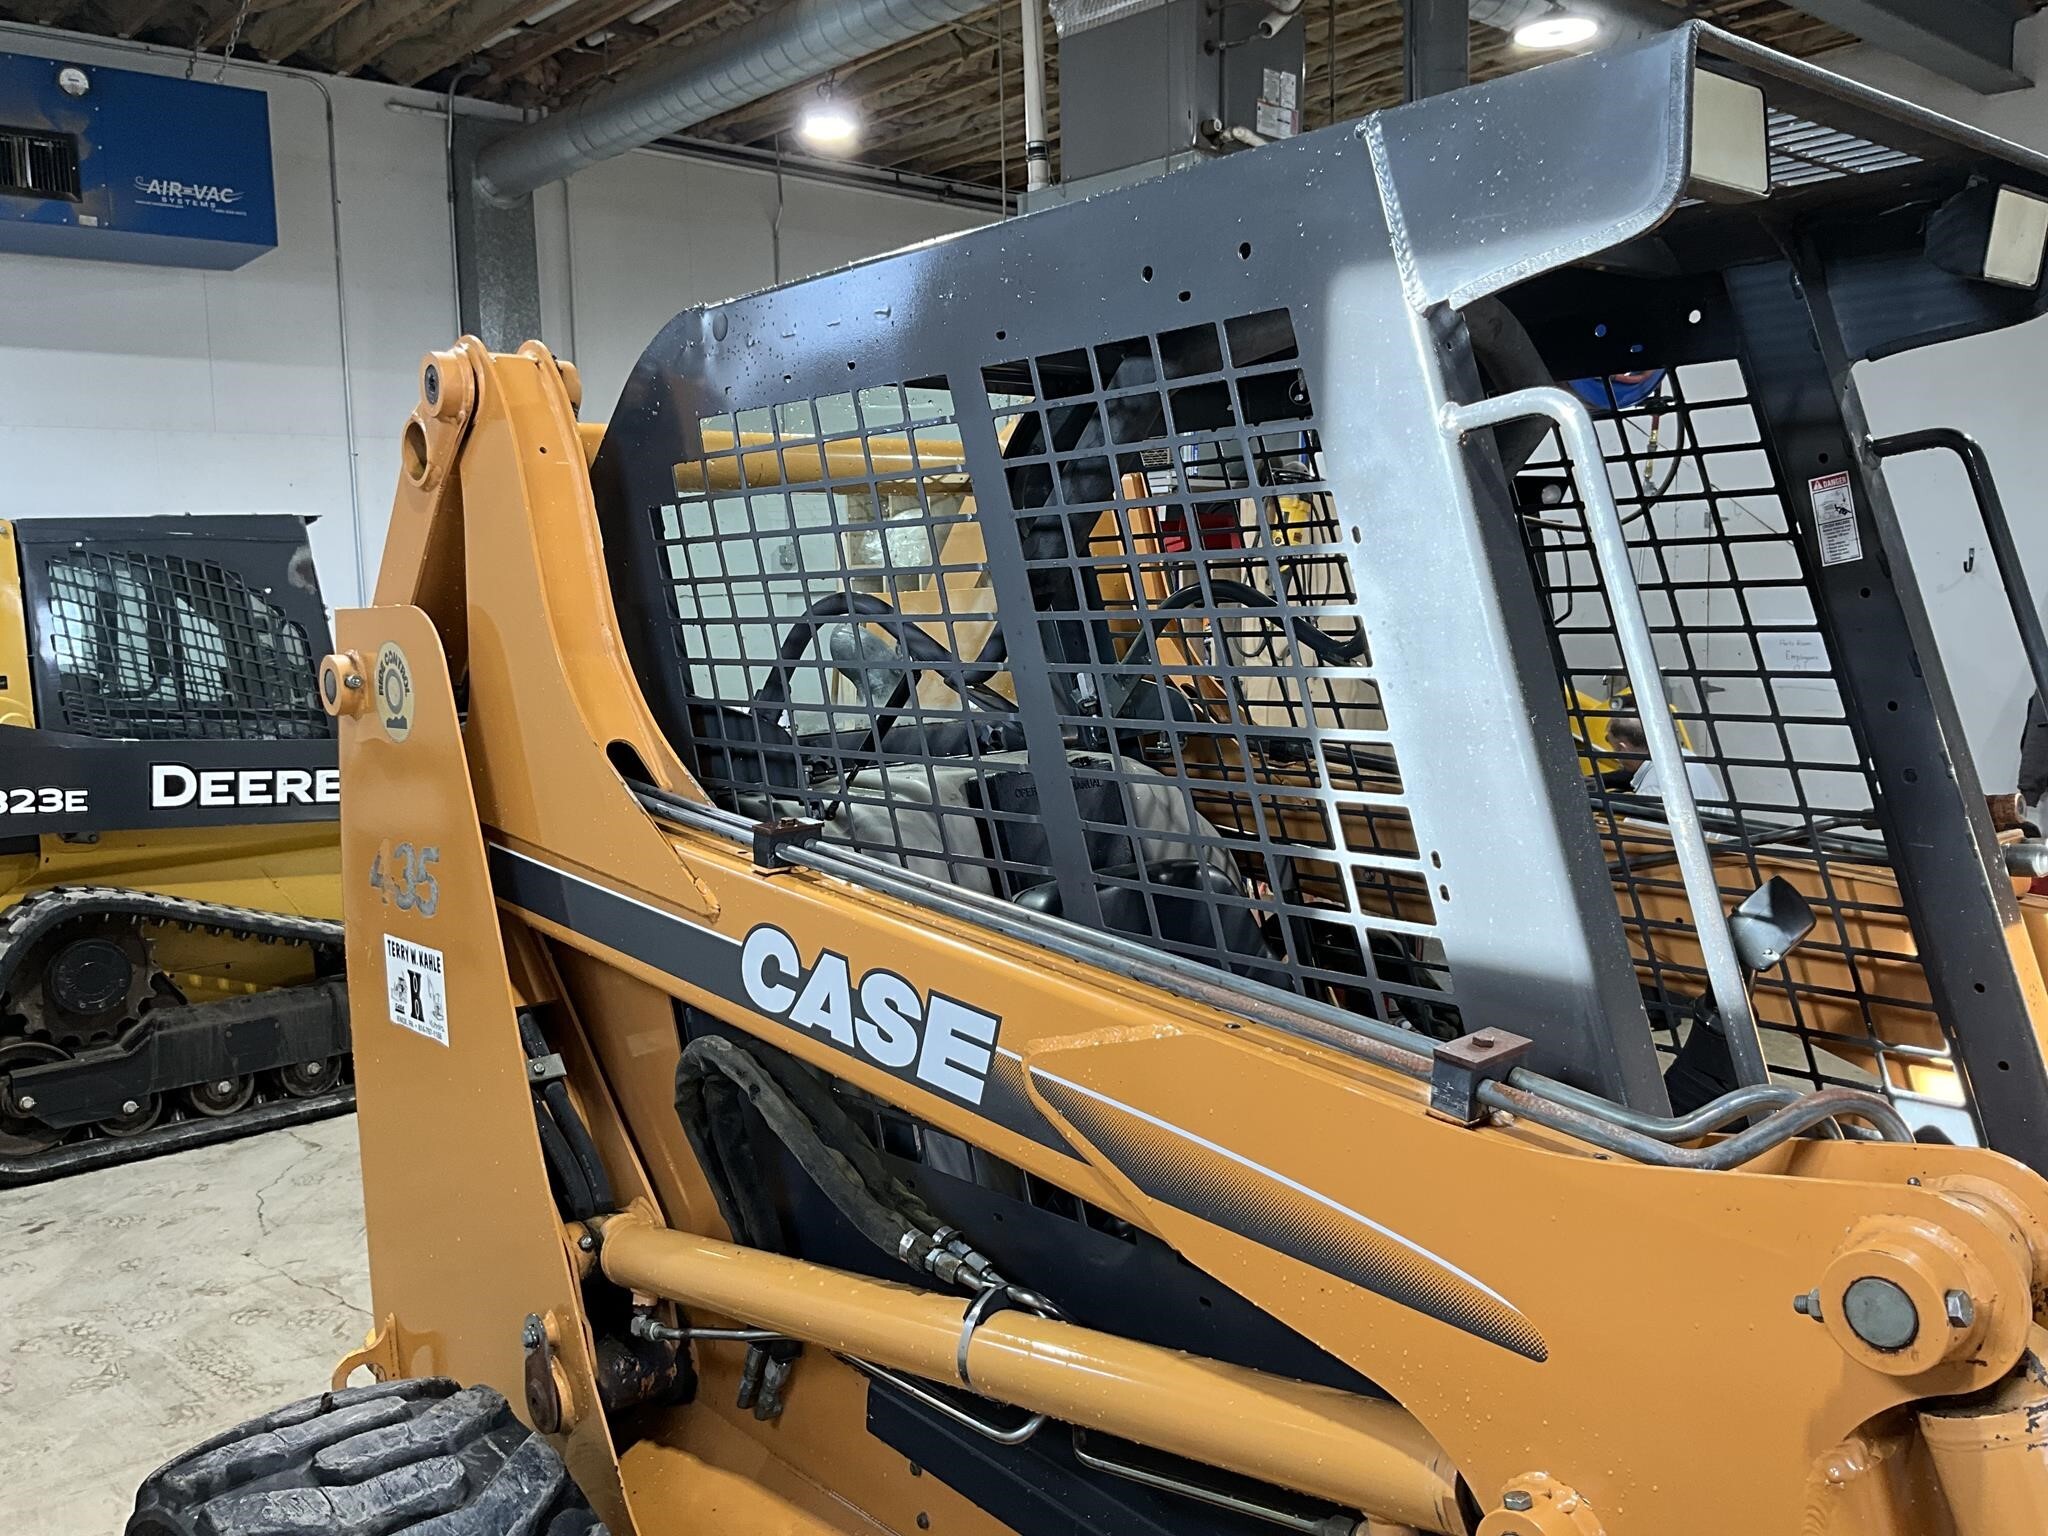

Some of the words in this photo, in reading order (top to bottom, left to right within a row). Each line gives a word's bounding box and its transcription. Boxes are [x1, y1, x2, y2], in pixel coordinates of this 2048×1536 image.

[161, 197, 216, 208] SYSTEMS
[1822, 476, 1847, 489] DANGER
[384, 650, 410, 697] CONTROL
[152, 764, 340, 807] DEERE
[387, 939, 409, 963] TERRY
[419, 950, 442, 974] KAHLE
[741, 927, 997, 1106] CASE
